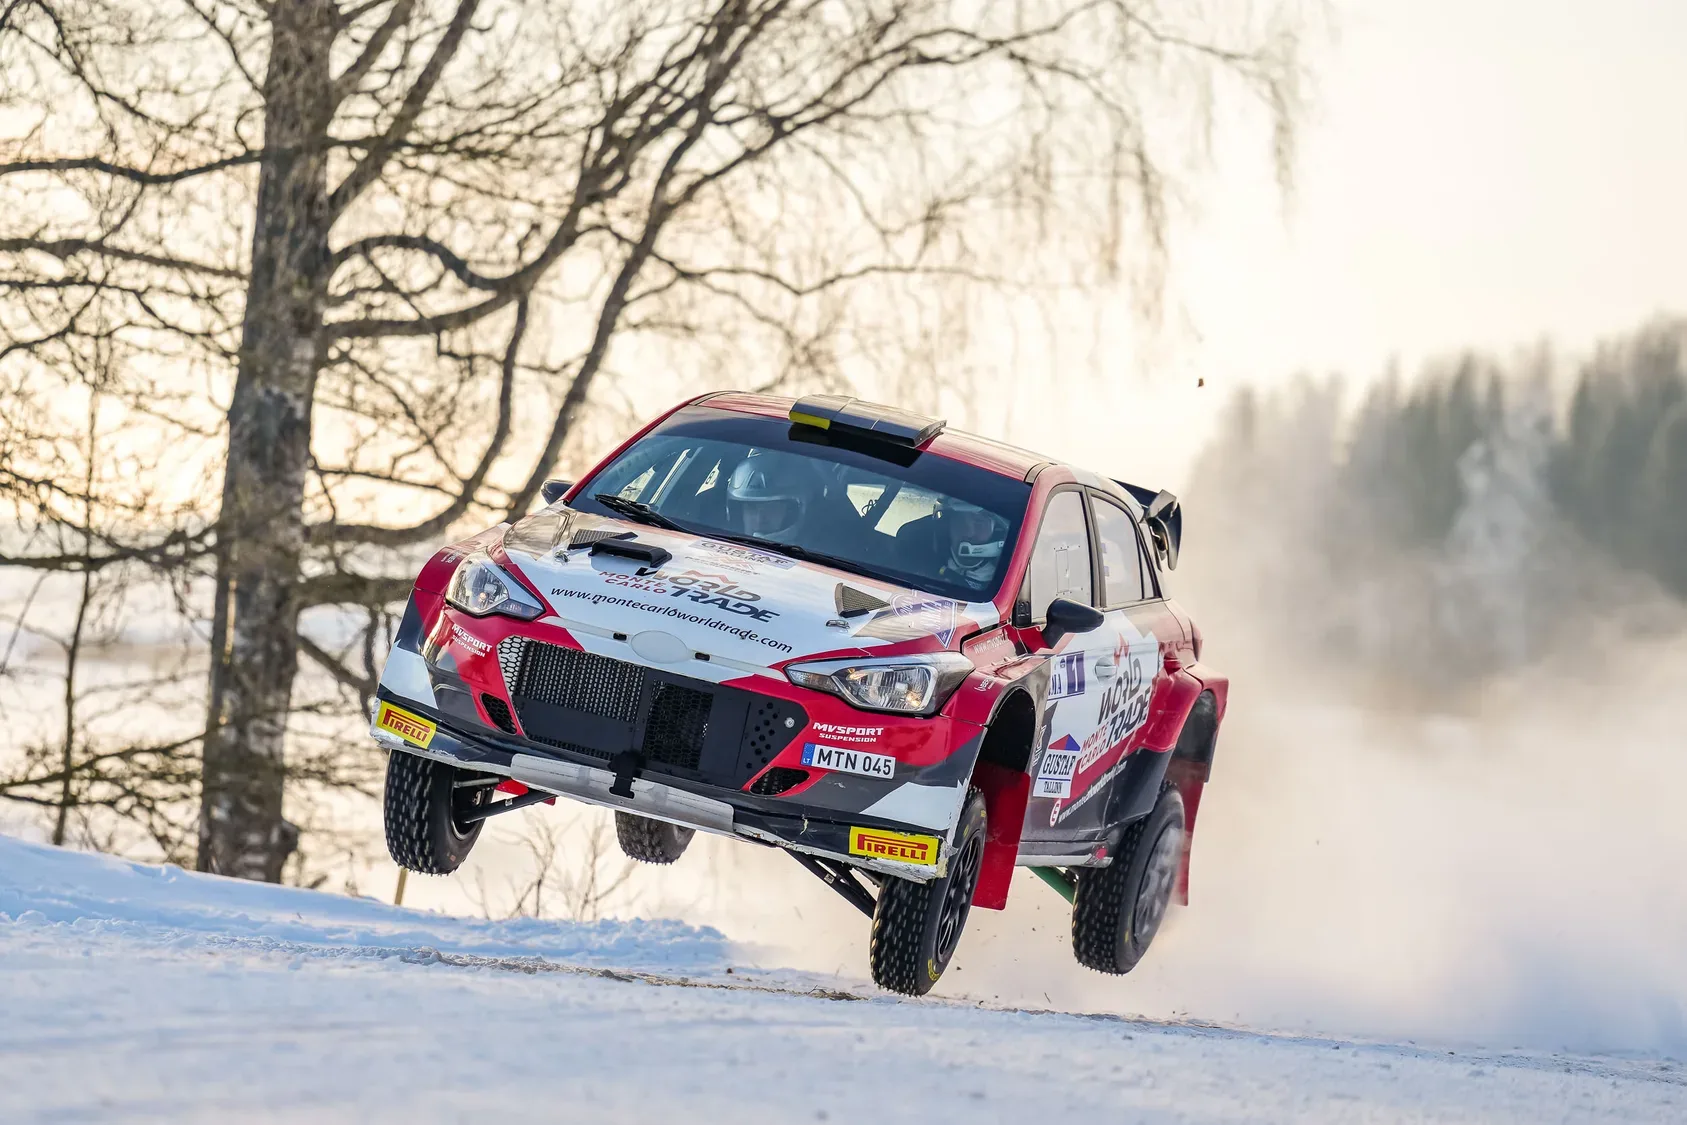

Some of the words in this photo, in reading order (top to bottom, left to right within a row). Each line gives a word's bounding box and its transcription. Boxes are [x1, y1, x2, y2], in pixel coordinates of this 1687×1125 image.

[599, 571, 666, 588] MONTE
[605, 578, 667, 594] CARLO
[635, 567, 761, 602] WORLD
[669, 585, 780, 623] TRADE
[550, 586, 793, 654] www.montecarloworldtrade.com
[451, 623, 493, 652] MVSPORT
[452, 634, 485, 658] SUSPENSION
[1097, 651, 1142, 725] WORLD
[382, 708, 431, 743] PIRELLI
[812, 722, 884, 736] MVSPORT
[818, 732, 877, 743] SUSPENSION
[816, 748, 858, 770] MTN
[861, 756, 892, 775] 045
[1042, 754, 1076, 776] GUSTAF
[857, 833, 929, 861] PIRELLI
